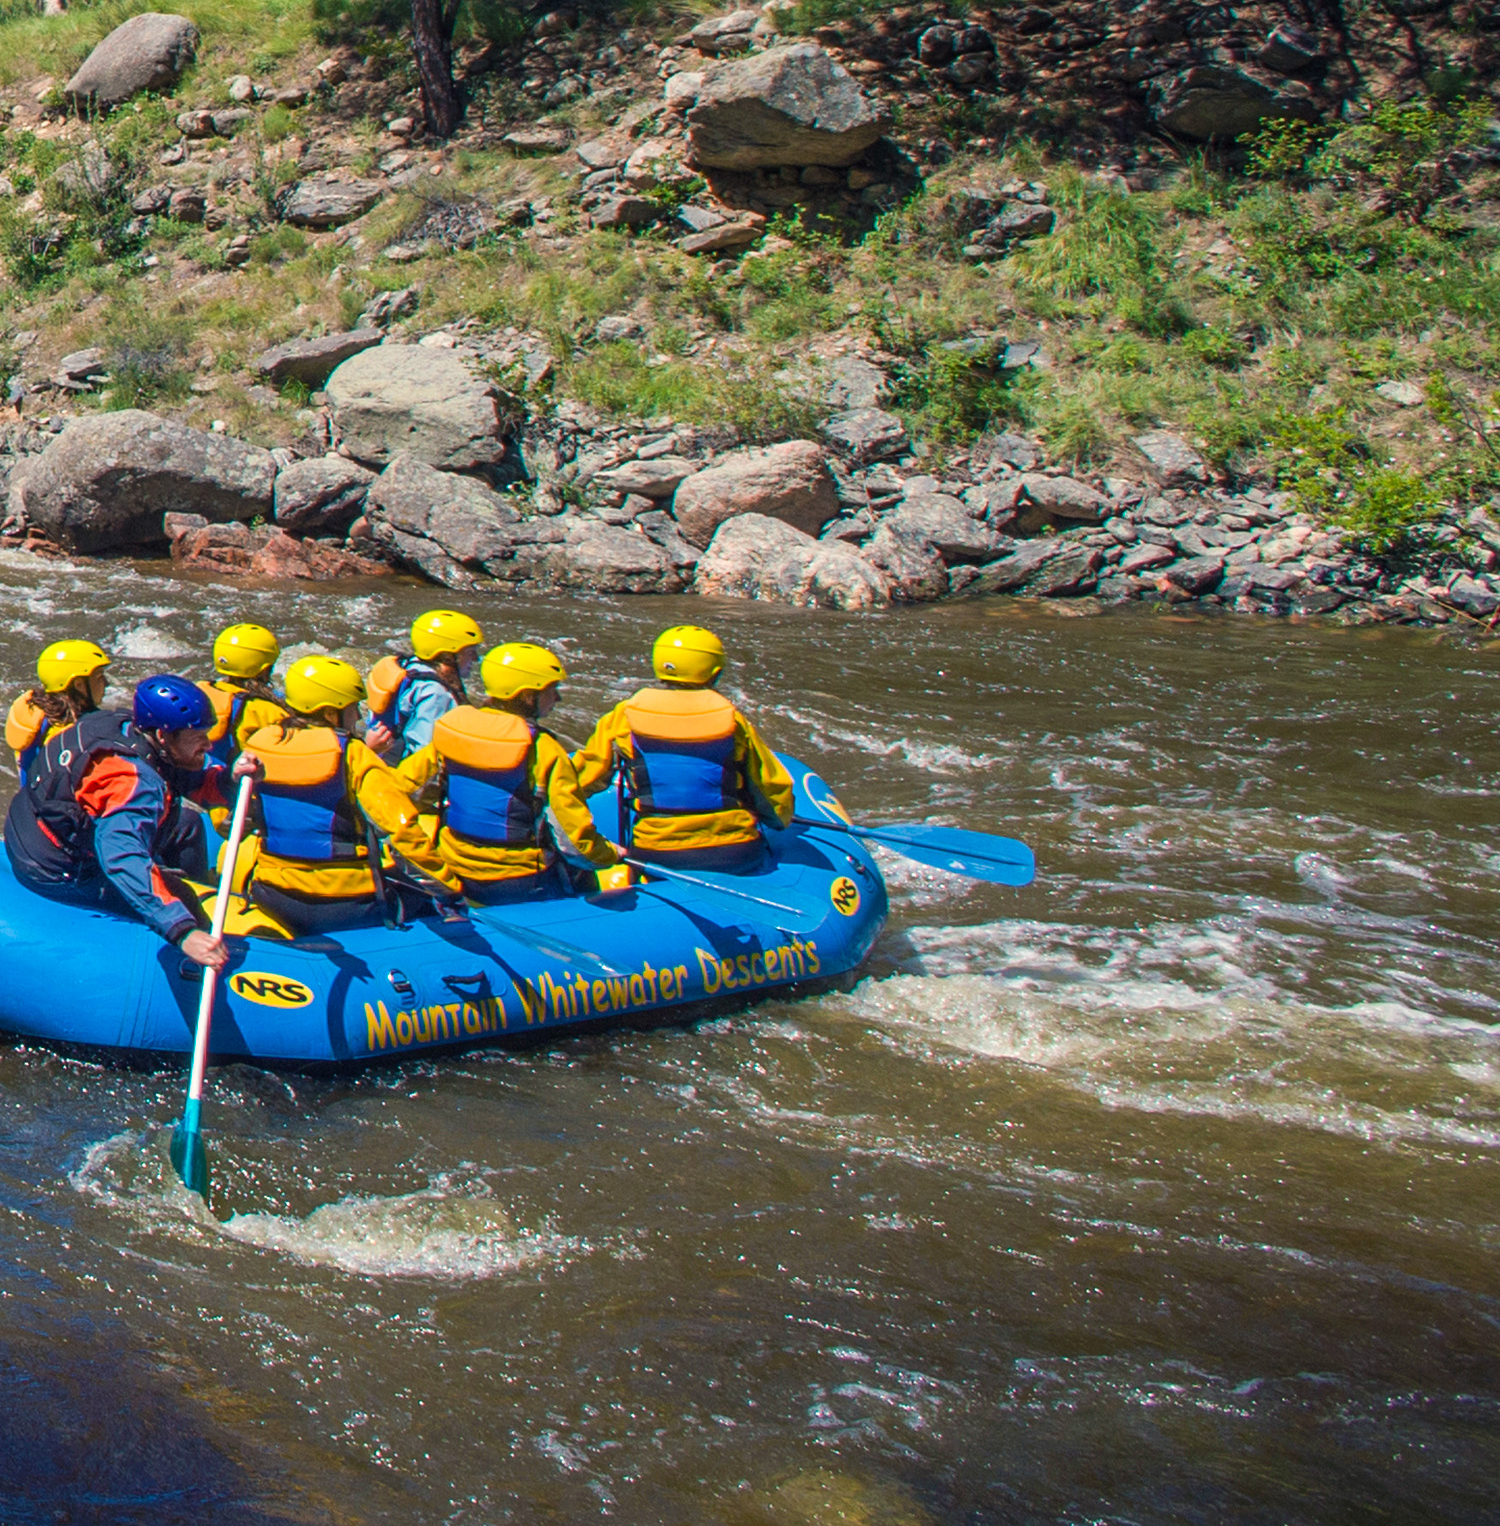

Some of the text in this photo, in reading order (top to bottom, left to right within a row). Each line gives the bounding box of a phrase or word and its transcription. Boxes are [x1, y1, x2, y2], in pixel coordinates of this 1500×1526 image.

[833, 877, 857, 914] NRS
[234, 975, 308, 1004] NRS
[364, 935, 821, 1051] Mountain Whitewater Descents
